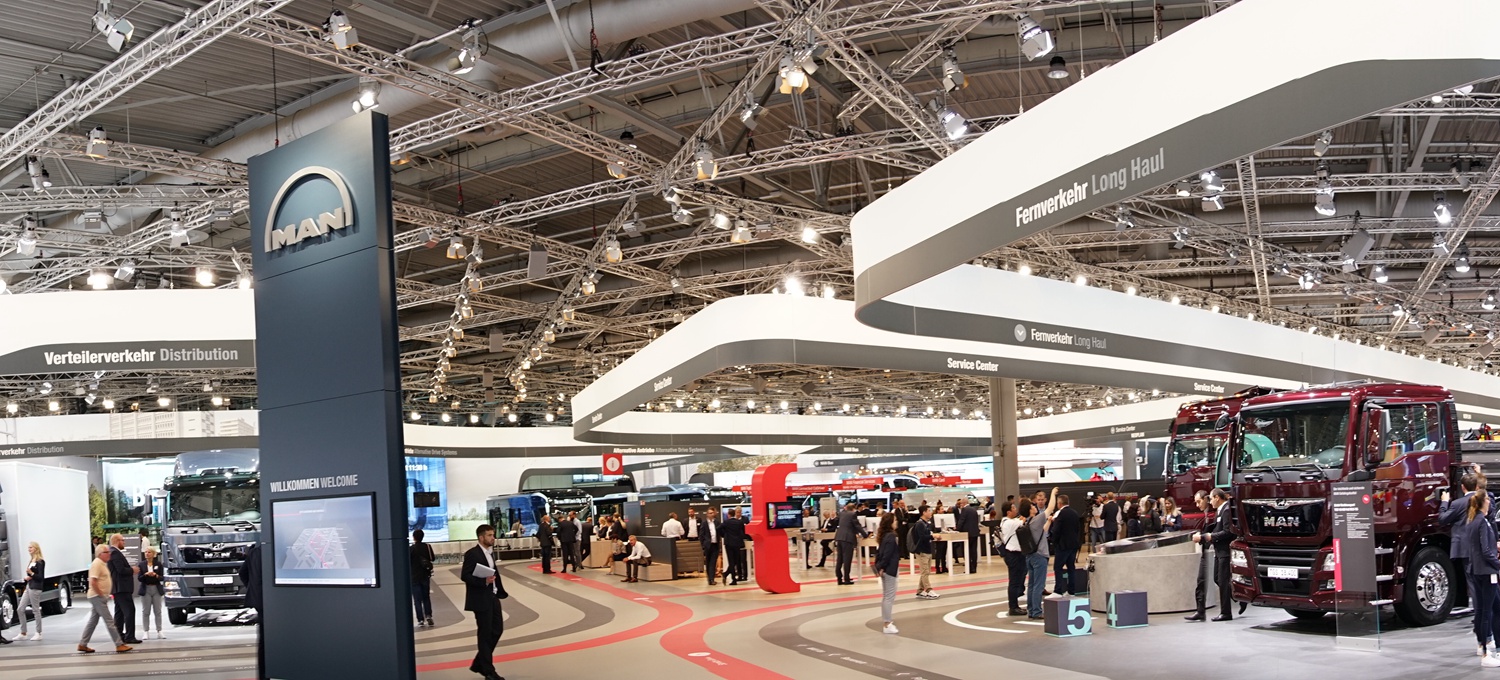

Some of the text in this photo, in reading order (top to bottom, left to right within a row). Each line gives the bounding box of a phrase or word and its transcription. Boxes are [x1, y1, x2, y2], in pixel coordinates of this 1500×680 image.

[1015, 147, 1164, 228] Fernverkehr Long Haul
[272, 207, 346, 250] MAN
[1031, 328, 1107, 349] Fernverkehr Long Haul
[44, 348, 238, 366] Verteilerverkehr Distribution
[947, 357, 999, 372] Service Center
[1194, 382, 1225, 393] Service Center
[26, 444, 64, 455] Distribution
[270, 474, 359, 493] WILLKOMMEN WELCOME
[1263, 516, 1300, 527] MAN
[1067, 598, 1092, 635] 5
[1106, 592, 1118, 628] 4
